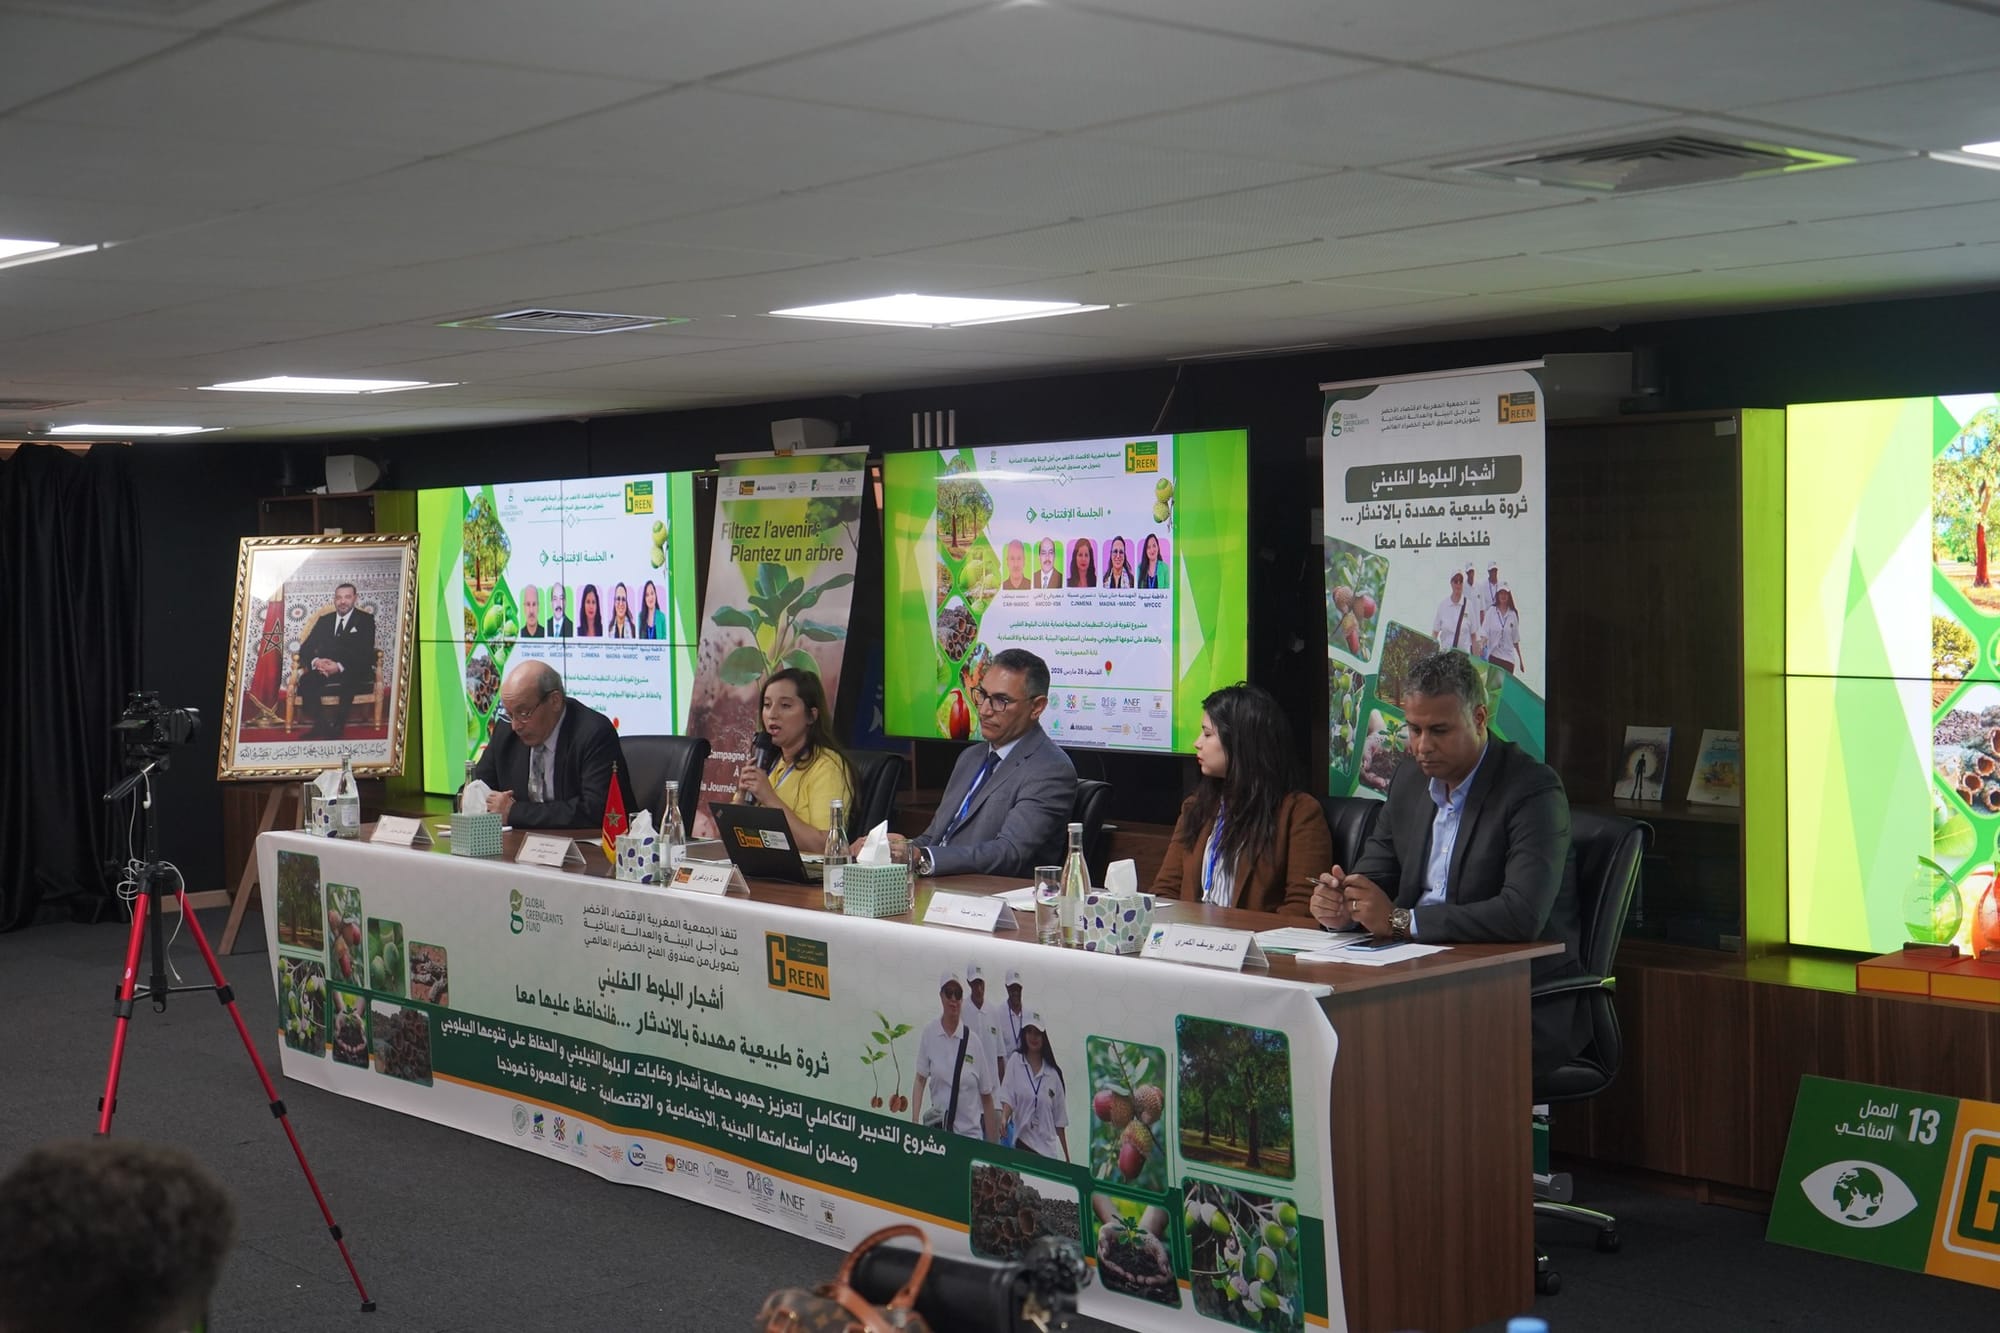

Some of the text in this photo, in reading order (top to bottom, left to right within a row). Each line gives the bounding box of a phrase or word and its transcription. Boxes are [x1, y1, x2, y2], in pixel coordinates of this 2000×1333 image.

[1498, 395, 1534, 422] GREEN
[1126, 444, 1156, 472] GREEN
[1372, 459, 1496, 497] أشجار البلوط الفليني
[625, 484, 652, 512] GREEN
[1500, 494, 1528, 518] ثروة
[1077, 508, 1104, 523] الجلسة
[1356, 504, 1402, 525] بالاندثار
[1405, 502, 1445, 518] مهددة
[1450, 499, 1495, 520] طبيعية
[720, 522, 760, 540] Filtrez
[1436, 531, 1490, 548] فلنحافظ
[1400, 532, 1432, 553] عليها
[584, 552, 607, 564] الجلسة
[730, 544, 843, 562] Plantez un arbre
[708, 782, 736, 793] Journée
[525, 896, 546, 910] GLOBAL
[583, 904, 609, 916] الأخضر
[526, 909, 563, 925] GREENGRANTS
[526, 920, 541, 932] FUND
[647, 913, 681, 928] المغربية
[620, 925, 662, 943] والعدالة
[682, 919, 718, 936] الجمعية
[720, 927, 737, 940] تنفذ
[584, 935, 612, 948] العالمي
[612, 941, 645, 952] الخضراء
[664, 932, 694, 948] البيئة
[696, 940, 716, 954] أجل
[1196, 940, 1214, 950] يوسف
[647, 946, 666, 958] المنح
[668, 951, 695, 962] صندوق
[720, 944, 738, 956] من
[766, 935, 825, 990] GREEN
[516, 984, 536, 1005] معا
[598, 968, 724, 1012] أشجار البلوط الفليني
[538, 988, 570, 1016] عليها
[635, 1011, 689, 1046] بالاندثار
[692, 1024, 736, 1052] مهددة
[740, 1036, 792, 1070] طبيعية
[496, 1056, 528, 1077] نموذجا
[796, 1048, 830, 1078] ثروة
[530, 1063, 568, 1086] المعمورة
[440, 1018, 946, 1157] مشروع التدبير التكاملي لتعزيز جهود حماية أشجار وغابات البلوط الفيليني و الحفاظ على تنوعها البيلوجي
[570, 1074, 588, 1095] غابة
[656, 1101, 664, 1116] و
[721, 1116, 754, 1142] البيئية
[1835, 1121, 1894, 1141] المناخي
[1859, 1099, 1941, 1145] 13 العمل
[756, 1126, 812, 1156] استدامتها
[632, 1150, 646, 1160] UICN
[816, 1144, 858, 1173] وضمان
[676, 1158, 700, 1174] GNDR
[780, 1189, 806, 1211] ANEF
